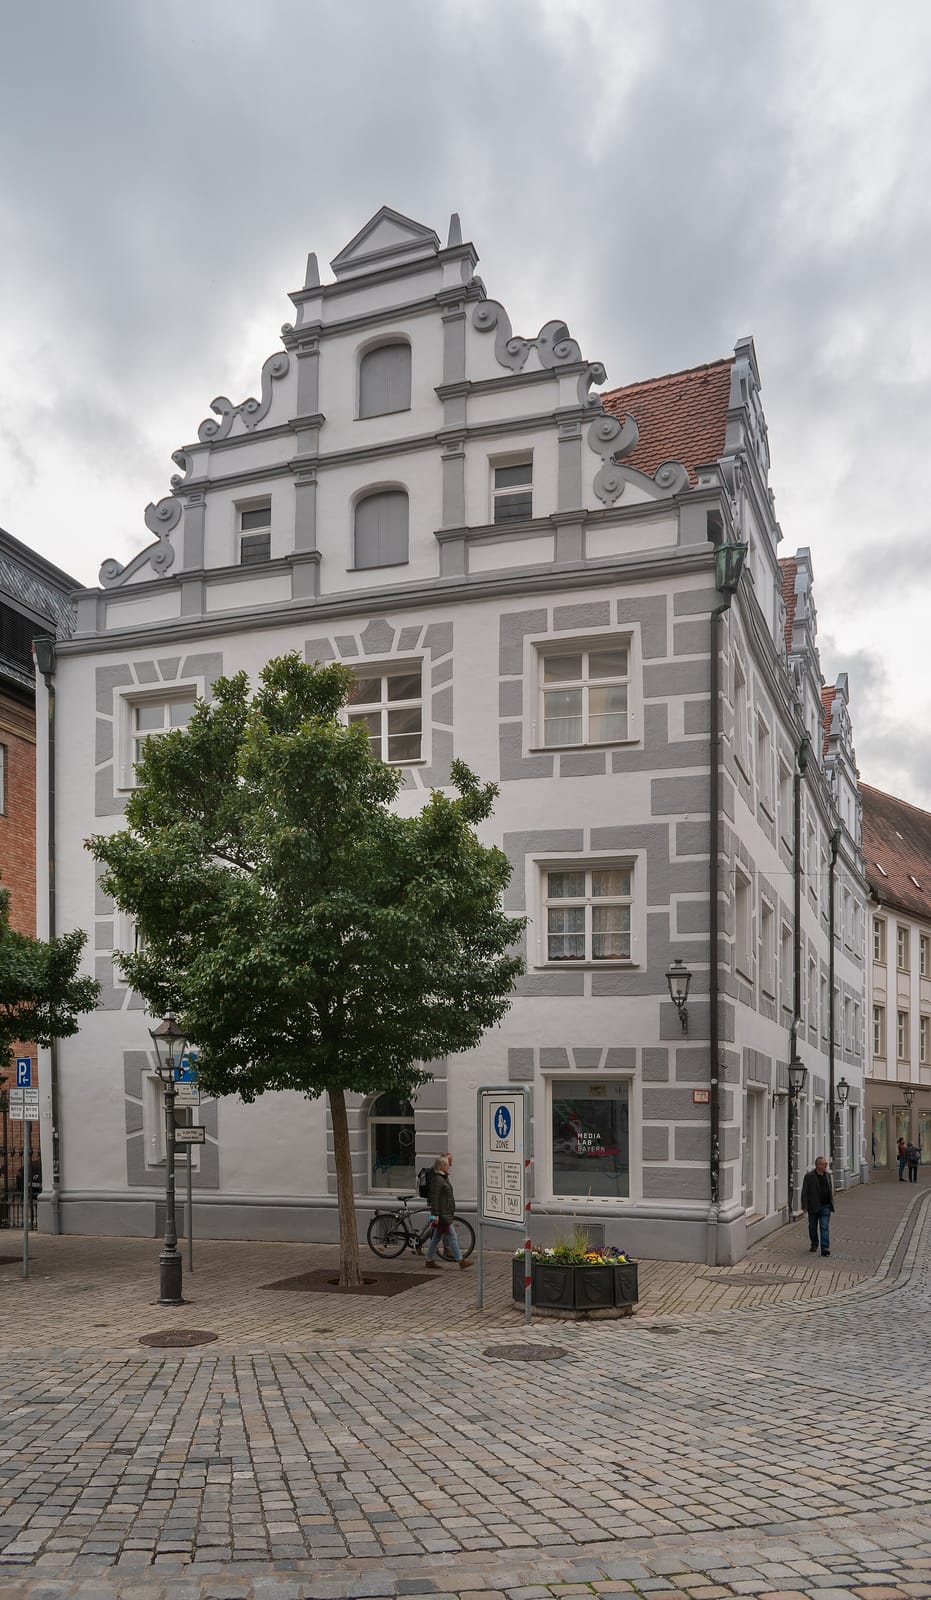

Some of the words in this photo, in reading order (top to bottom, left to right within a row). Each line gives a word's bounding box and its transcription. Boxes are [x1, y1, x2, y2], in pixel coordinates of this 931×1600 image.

[18, 1062, 27, 1084] P
[495, 1140, 509, 1149] ZONE
[508, 1198, 518, 1206] TAXI
